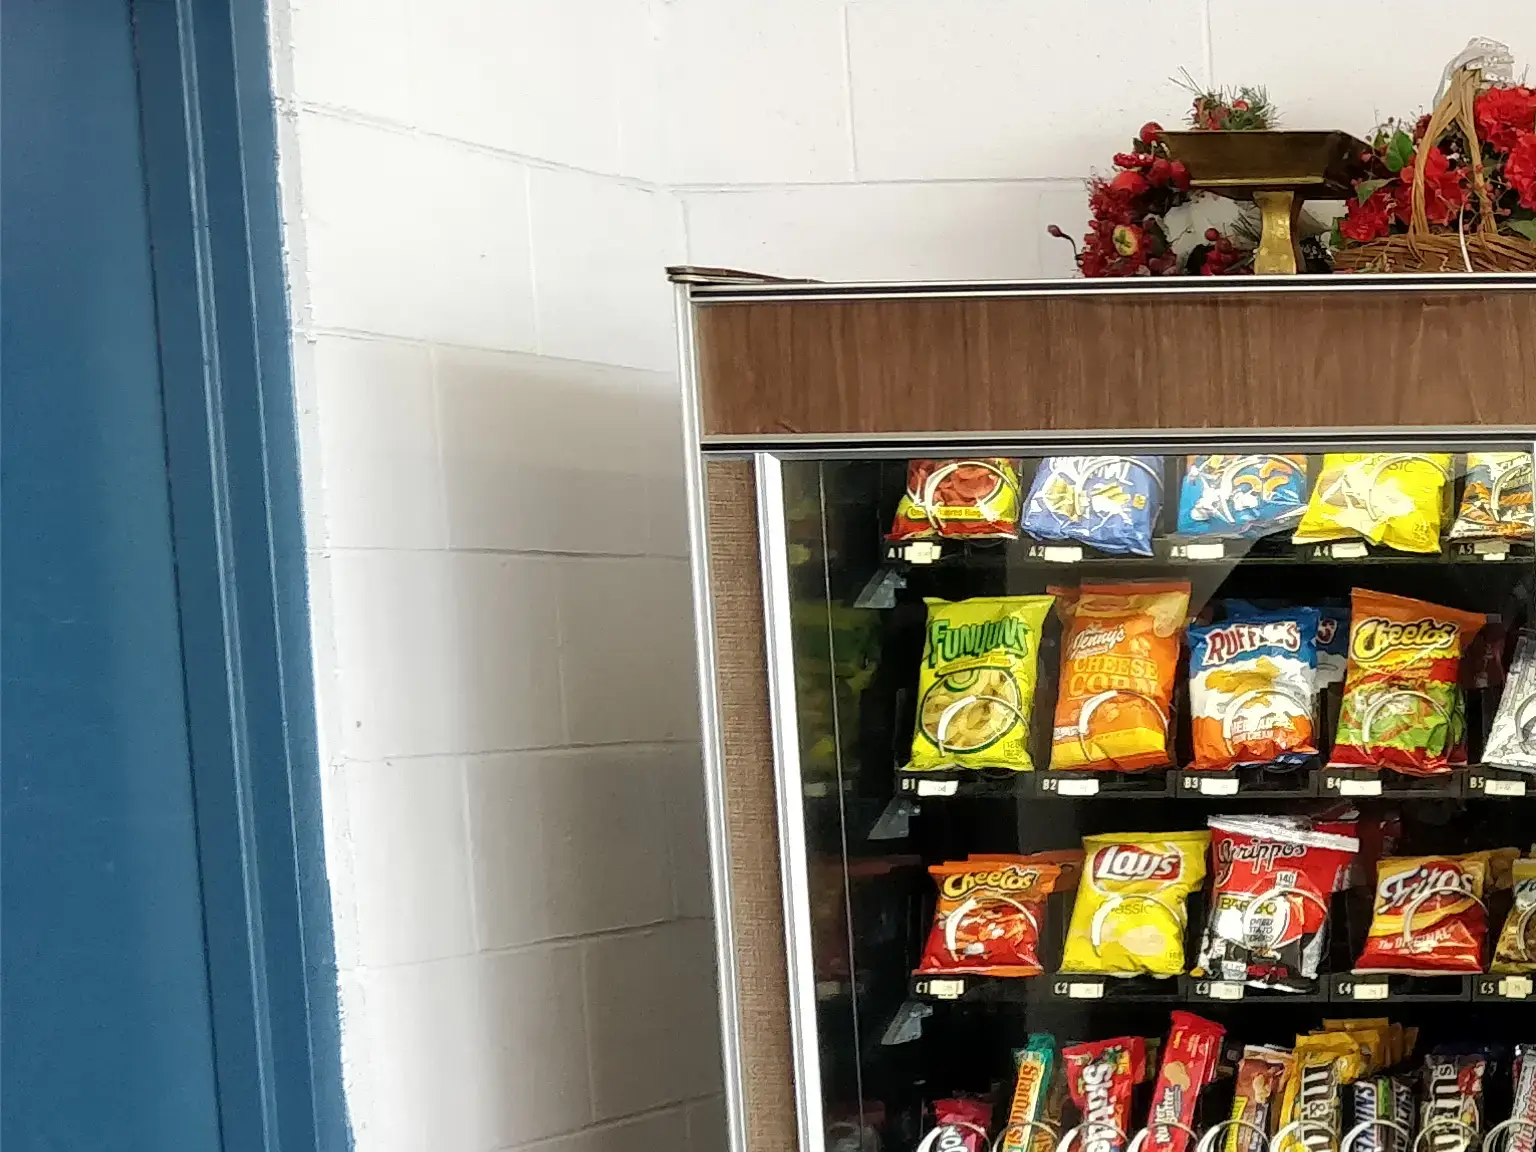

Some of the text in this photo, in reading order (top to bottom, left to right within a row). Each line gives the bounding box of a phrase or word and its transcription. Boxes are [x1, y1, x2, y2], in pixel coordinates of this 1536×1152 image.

[1028, 545, 1044, 558] A2
[1171, 545, 1187, 558] A3
[1313, 546, 1329, 558] A4
[1459, 543, 1474, 555] A5
[1203, 622, 1299, 665] RUFFS
[1352, 618, 1459, 661] Cheetos
[1074, 655, 1158, 681] CHEESE
[902, 777, 916, 791] B1
[1042, 778, 1057, 791] B2
[1185, 776, 1199, 789] B3
[1327, 776, 1342, 789] B4
[1470, 776, 1485, 789] B5
[941, 866, 1041, 899] Cheetos
[1377, 866, 1477, 914] Fritos
[916, 980, 928, 994] C1
[1055, 982, 1068, 995] C2
[1196, 982, 1209, 995] C3
[1338, 982, 1352, 995] C4
[1481, 981, 1495, 995] C5
